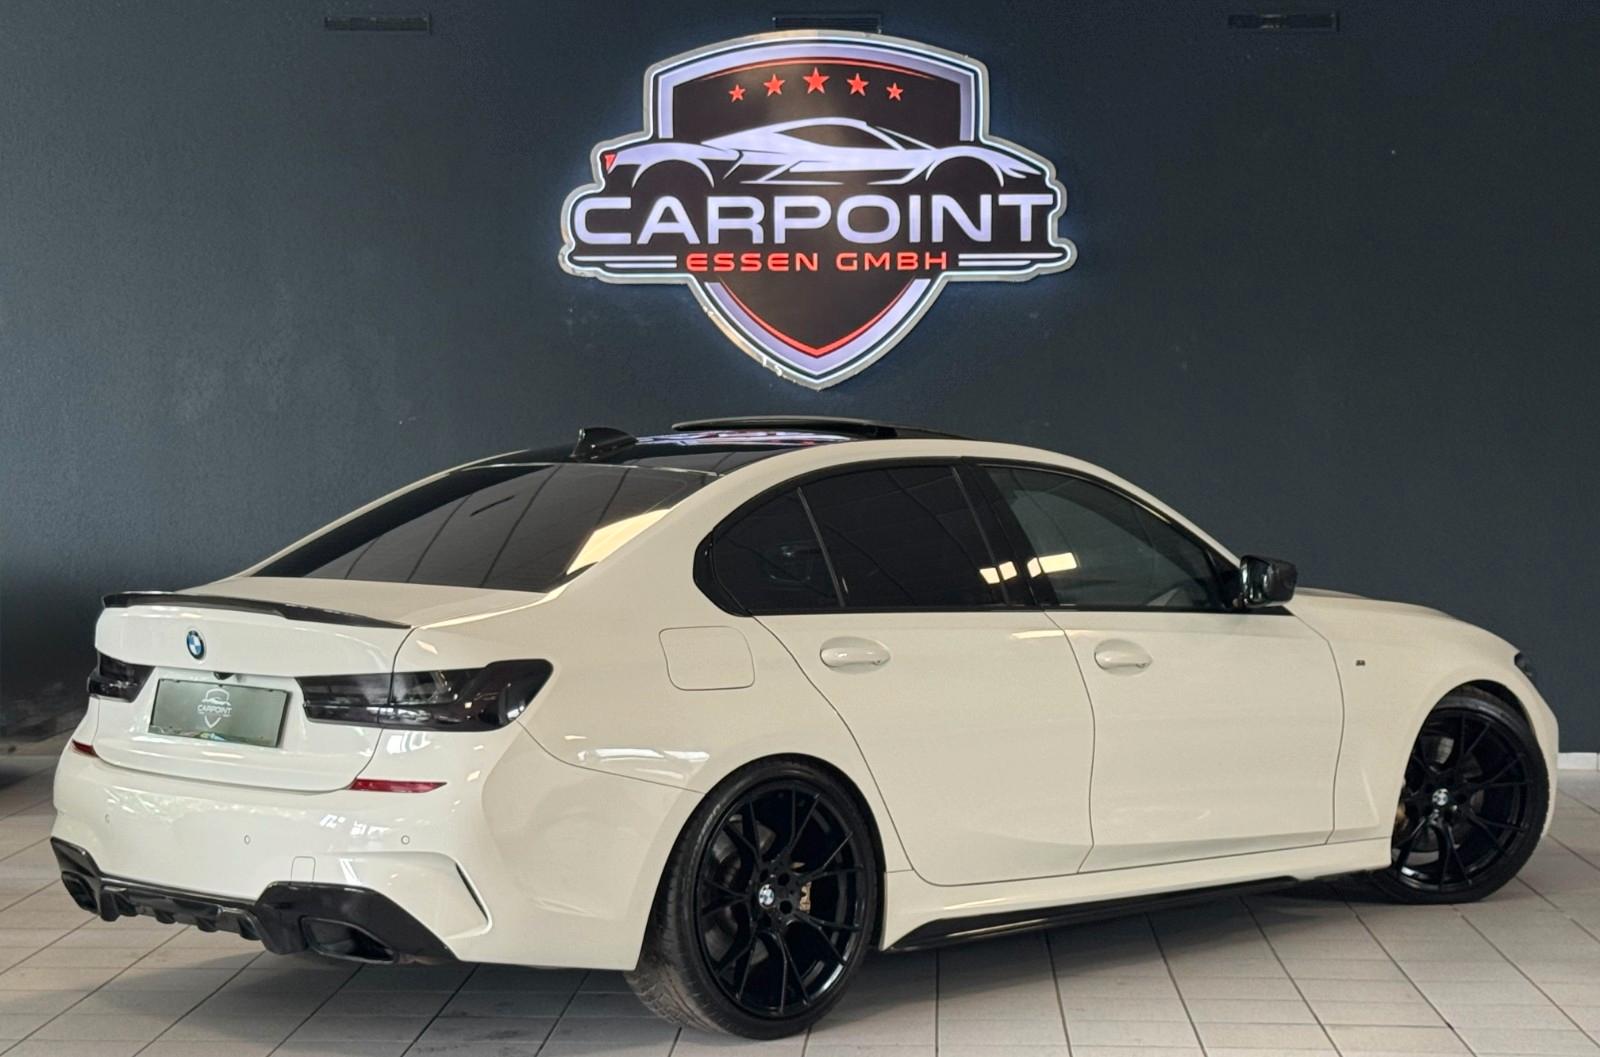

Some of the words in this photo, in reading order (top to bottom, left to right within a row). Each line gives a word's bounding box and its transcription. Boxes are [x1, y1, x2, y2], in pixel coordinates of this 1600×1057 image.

[573, 194, 1053, 244] CARPOINT
[686, 252, 818, 272] ESSEN
[836, 252, 948, 271] GMBH
[197, 704, 233, 715] CARPOINT
